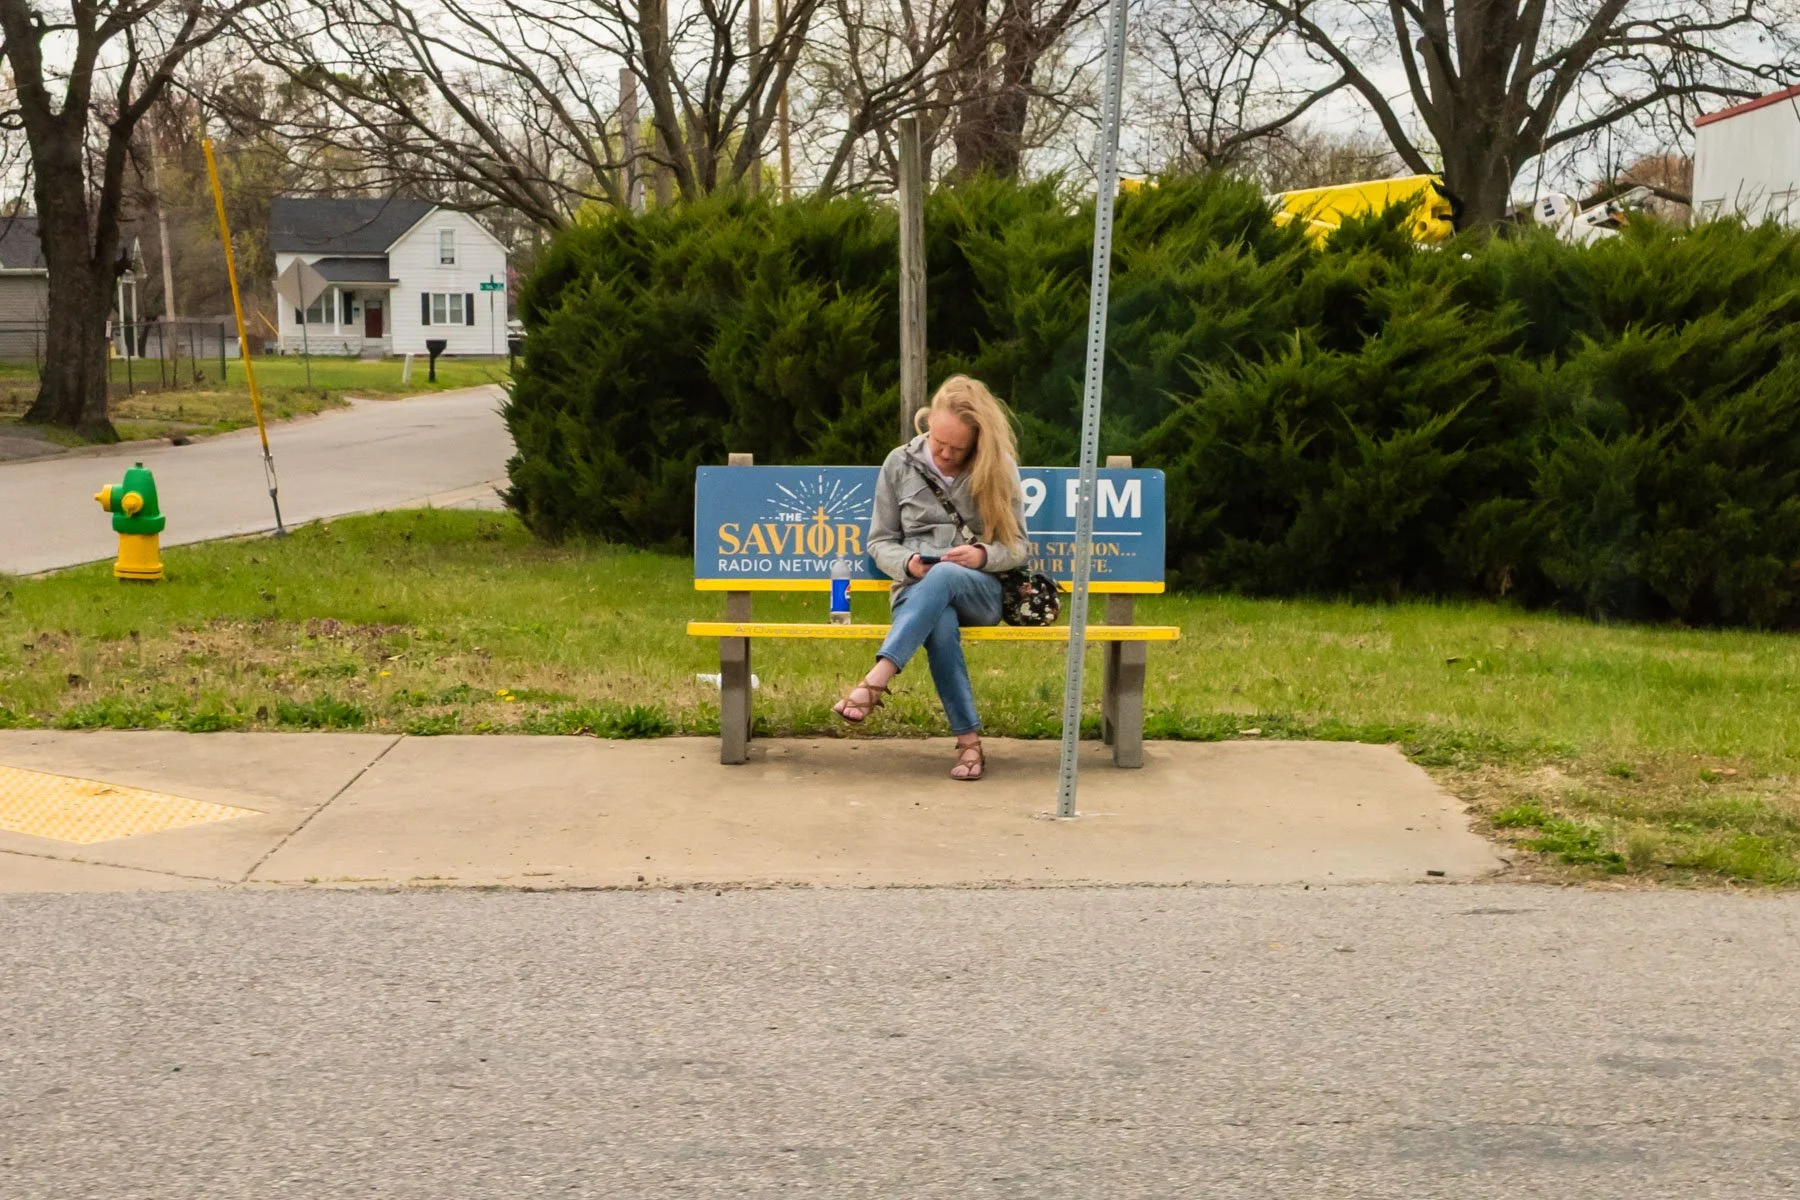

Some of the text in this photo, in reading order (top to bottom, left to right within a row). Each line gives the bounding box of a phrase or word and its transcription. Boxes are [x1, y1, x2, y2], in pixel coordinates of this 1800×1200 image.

[779, 513, 802, 522] THE
[718, 522, 865, 557] SAVIOR
[1046, 542, 1136, 556] STAION...
[718, 559, 772, 572] RADIO
[1028, 559, 1063, 572] OUR
